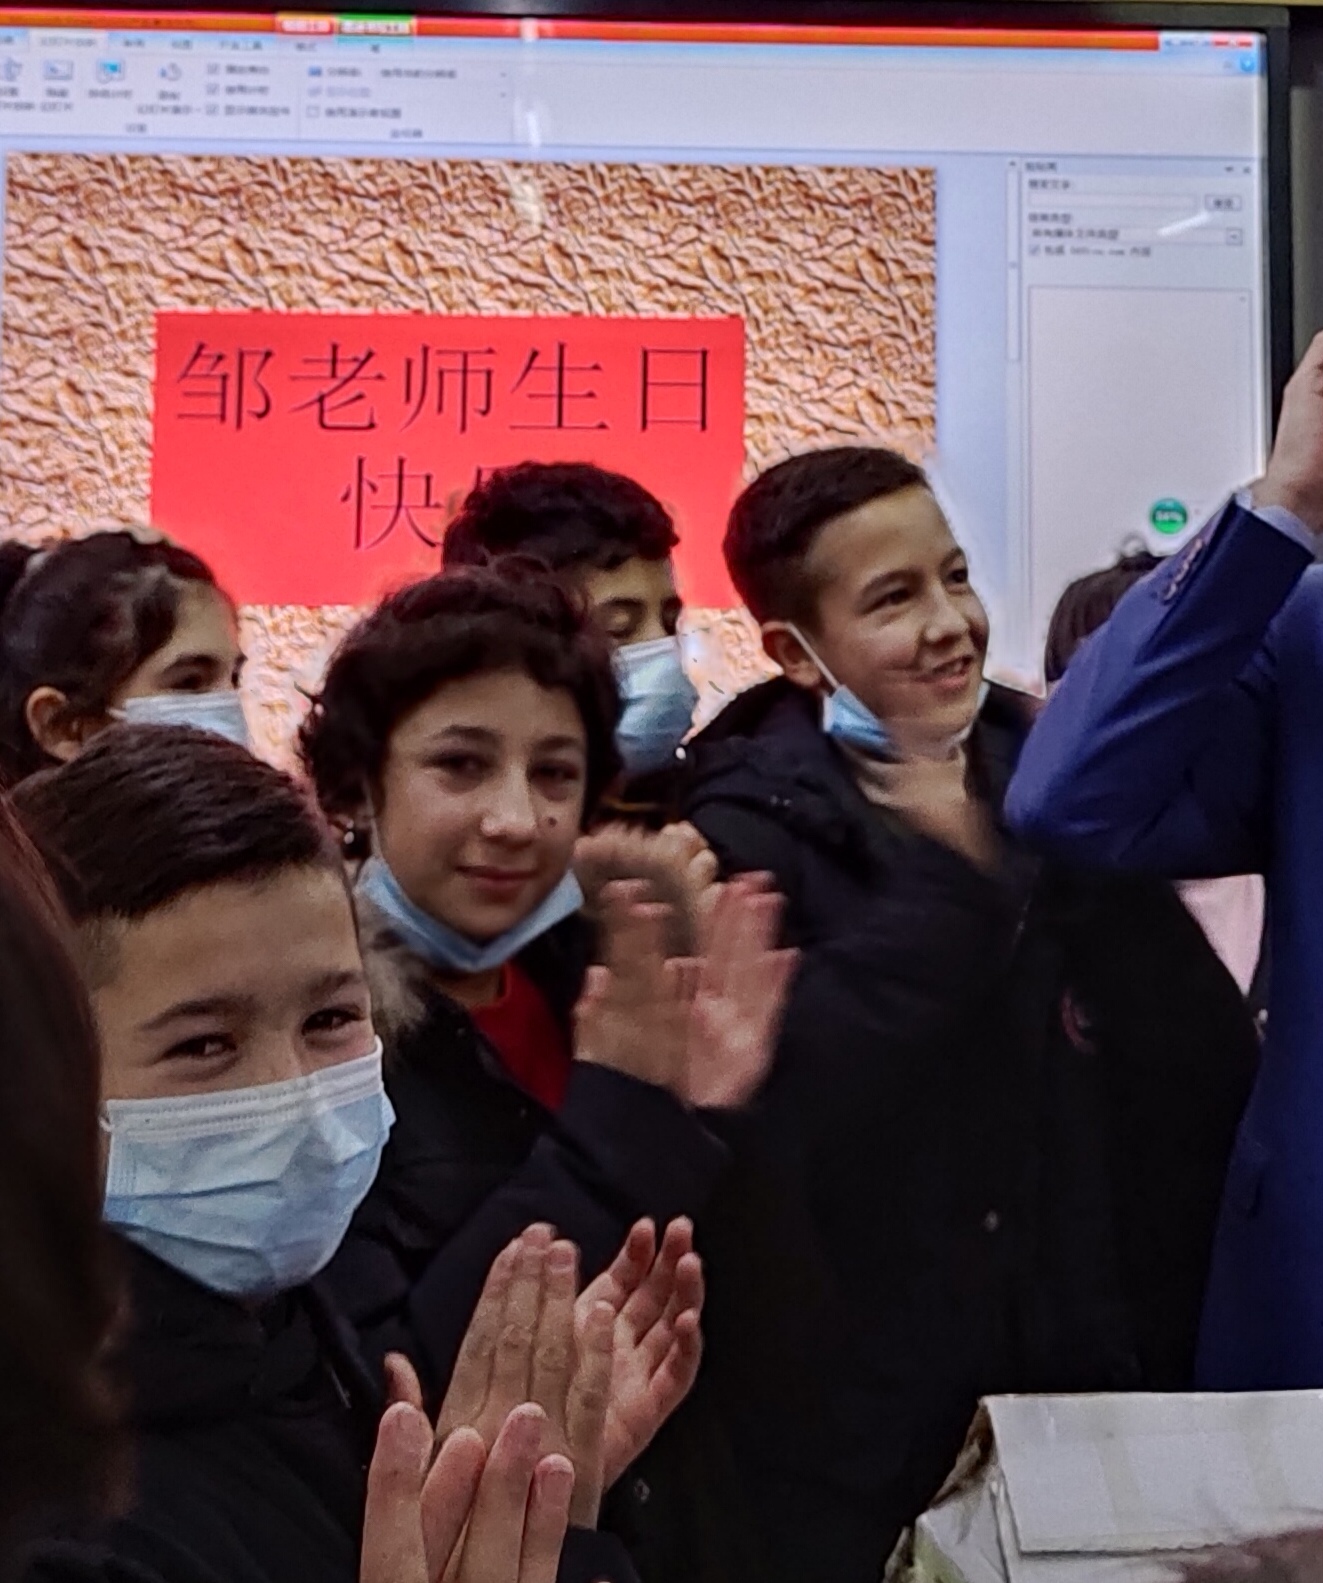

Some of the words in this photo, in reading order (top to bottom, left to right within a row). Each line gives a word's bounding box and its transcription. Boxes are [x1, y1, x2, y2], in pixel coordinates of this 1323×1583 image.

[175, 340, 712, 434] 邹老师生日
